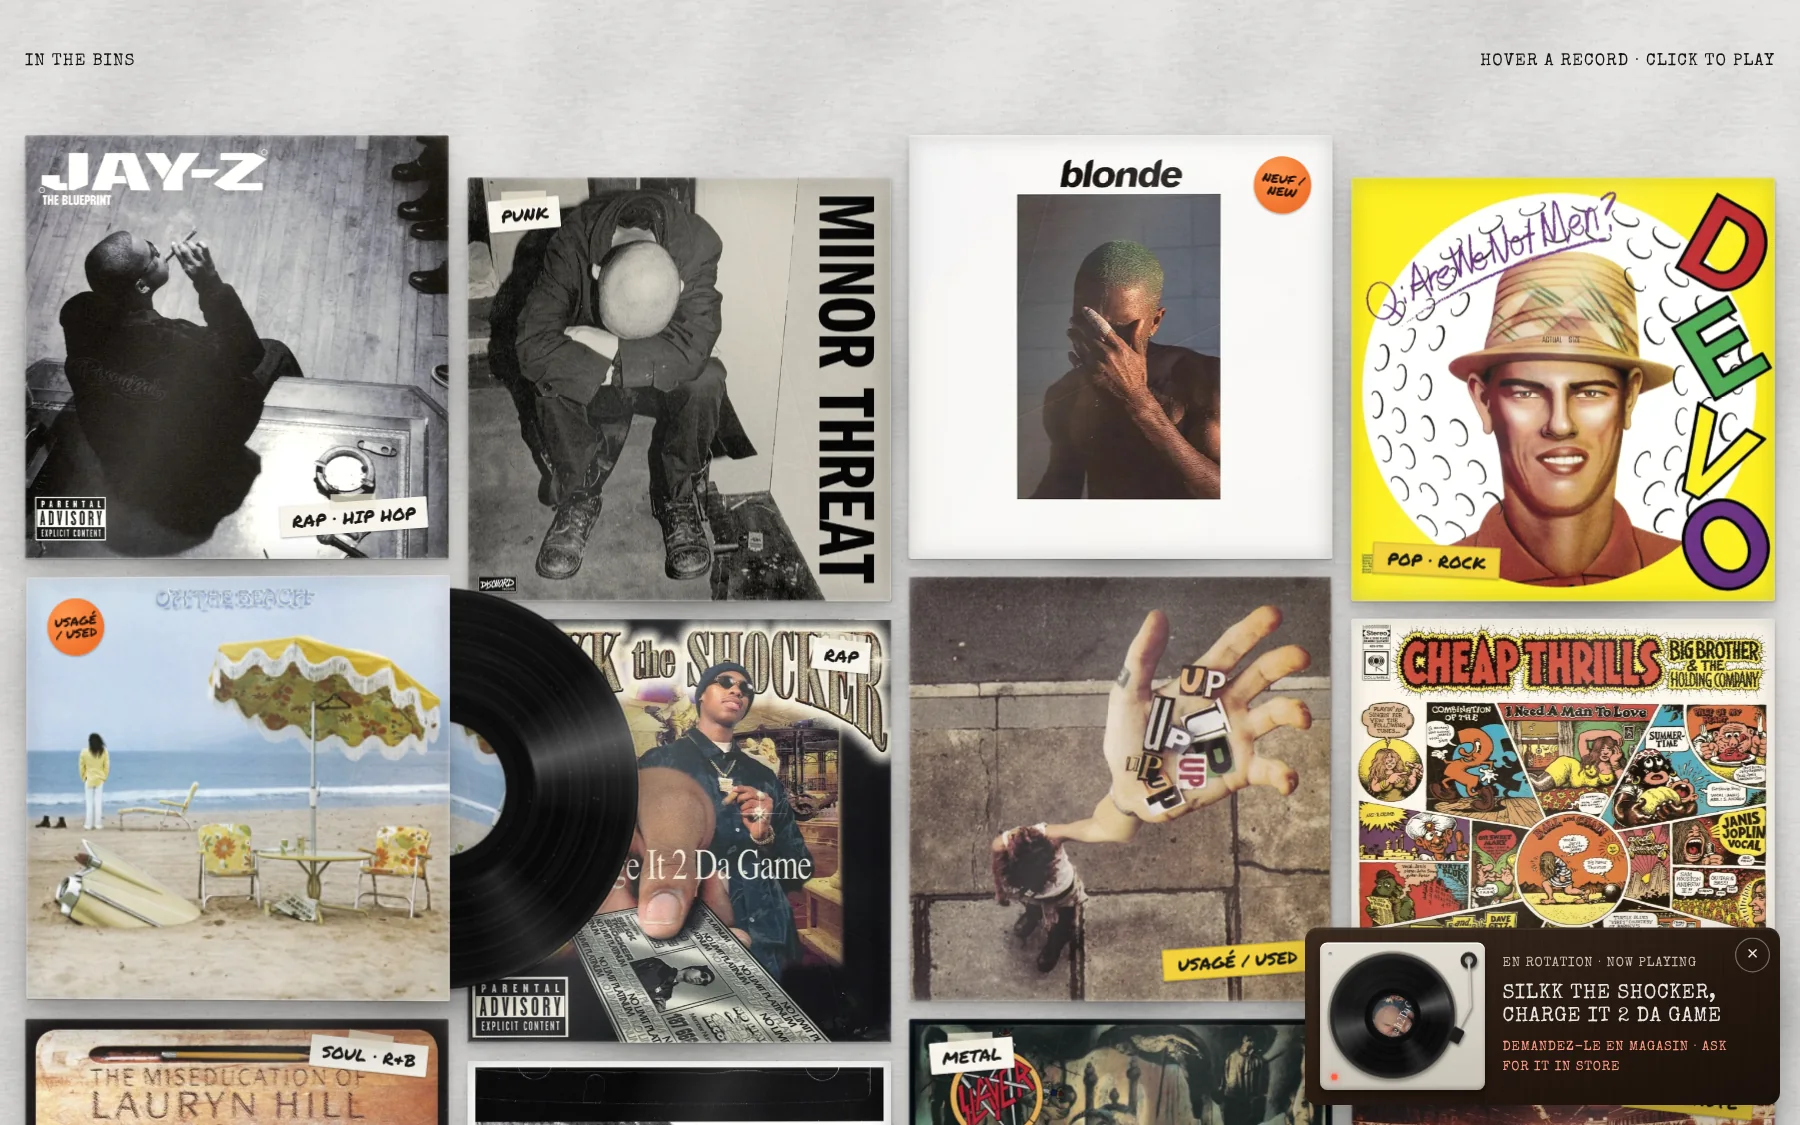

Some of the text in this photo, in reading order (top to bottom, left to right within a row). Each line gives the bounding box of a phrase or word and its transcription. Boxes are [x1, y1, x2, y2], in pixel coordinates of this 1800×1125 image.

[25, 53, 134, 66] IN THE BINS
[1480, 53, 1774, 66] HOVER A RECORD CLICK TO PLAY
[41, 153, 267, 191] JAY-Z
[1060, 159, 1183, 188] blonde
[1262, 173, 1297, 186] NEUF
[43, 195, 111, 205] THE BLUEPRINT
[1266, 186, 1298, 198] NEW
[501, 206, 550, 223] PUNK
[1366, 191, 1617, 321] Q: Are We Not Men?
[1541, 336, 1580, 344] ACTUAL SIZE
[818, 195, 876, 584] MINOR THREAT
[1671, 192, 1772, 591] DEVO
[41, 500, 101, 508] PARENTAL
[40, 510, 103, 526] ADVISORY
[292, 506, 417, 529] RAP HIP HOP
[41, 529, 101, 537] EXPLICIT CONTENT
[1387, 551, 1423, 568] POP
[1437, 553, 1487, 570] ROCK
[54, 611, 97, 629] USAGÉ
[65, 627, 97, 640] USED
[823, 649, 860, 663] RAP
[1669, 641, 1760, 661] BIG BROTHER
[632, 639, 676, 681] the
[1403, 635, 1663, 686] CHEAP THRILLS
[1686, 660, 1725, 671] & THE
[1180, 666, 1226, 698] UP
[1670, 672, 1759, 687] HOLDING COMPANY
[1432, 706, 1491, 714] COMBINATION
[1505, 705, 1647, 718] I Need A Man To Love
[1649, 731, 1685, 741] SUMMER-
[1655, 740, 1678, 748] TIME
[1179, 758, 1205, 787] UP
[1722, 811, 1760, 829] JANIS
[1722, 825, 1765, 839] JOPLIN
[1728, 840, 1762, 851] VOCAL
[646, 849, 665, 880] It
[672, 849, 688, 880] 2
[695, 849, 731, 880] Da
[737, 848, 812, 880] Game
[604, 919, 634, 961] SHOCKER
[606, 939, 627, 966] PLATINUM
[703, 932, 713, 942] NO
[711, 939, 724, 956] LIMIT
[722, 954, 750, 986] PLATINUM
[1178, 950, 1297, 972] USAGÉ USED
[585, 951, 604, 977] PLATINUM
[1502, 956, 1696, 967] EN ROTATION NOW PLAYING
[481, 983, 560, 993] PARENTAL
[596, 956, 608, 966] NO
[602, 966, 617, 983] LIMIT
[611, 982, 635, 1017] PLATINUM
[1503, 983, 1715, 1002] SILKK THE SHOCKER,
[738, 964, 751, 975] NO
[748, 975, 765, 991] LIMIT
[761, 991, 796, 1027] PLATINUM
[480, 997, 561, 1016] ADVISORY
[626, 993, 651, 1025] NO LIMIT
[1503, 1006, 1721, 1022] CHARGE IT 2 DA GAME
[667, 1013, 690, 1028] 187
[759, 1013, 774, 1026] NO
[780, 1001, 796, 1014] NO
[792, 1013, 813, 1033] LIMIT
[481, 1021, 560, 1031] EXPLICIT CONTENT
[322, 1046, 366, 1062] SOUL
[1502, 1040, 1727, 1051] DEMANDEZ-LE EN MAGASIN ASK
[942, 1048, 1002, 1065] METAL
[1502, 1060, 1620, 1071] FOR IT IN STORE
[90, 1067, 134, 1087] THE
[144, 1067, 326, 1087] MISEDUCATION
[92, 1091, 365, 1119] LAURYN HILL
